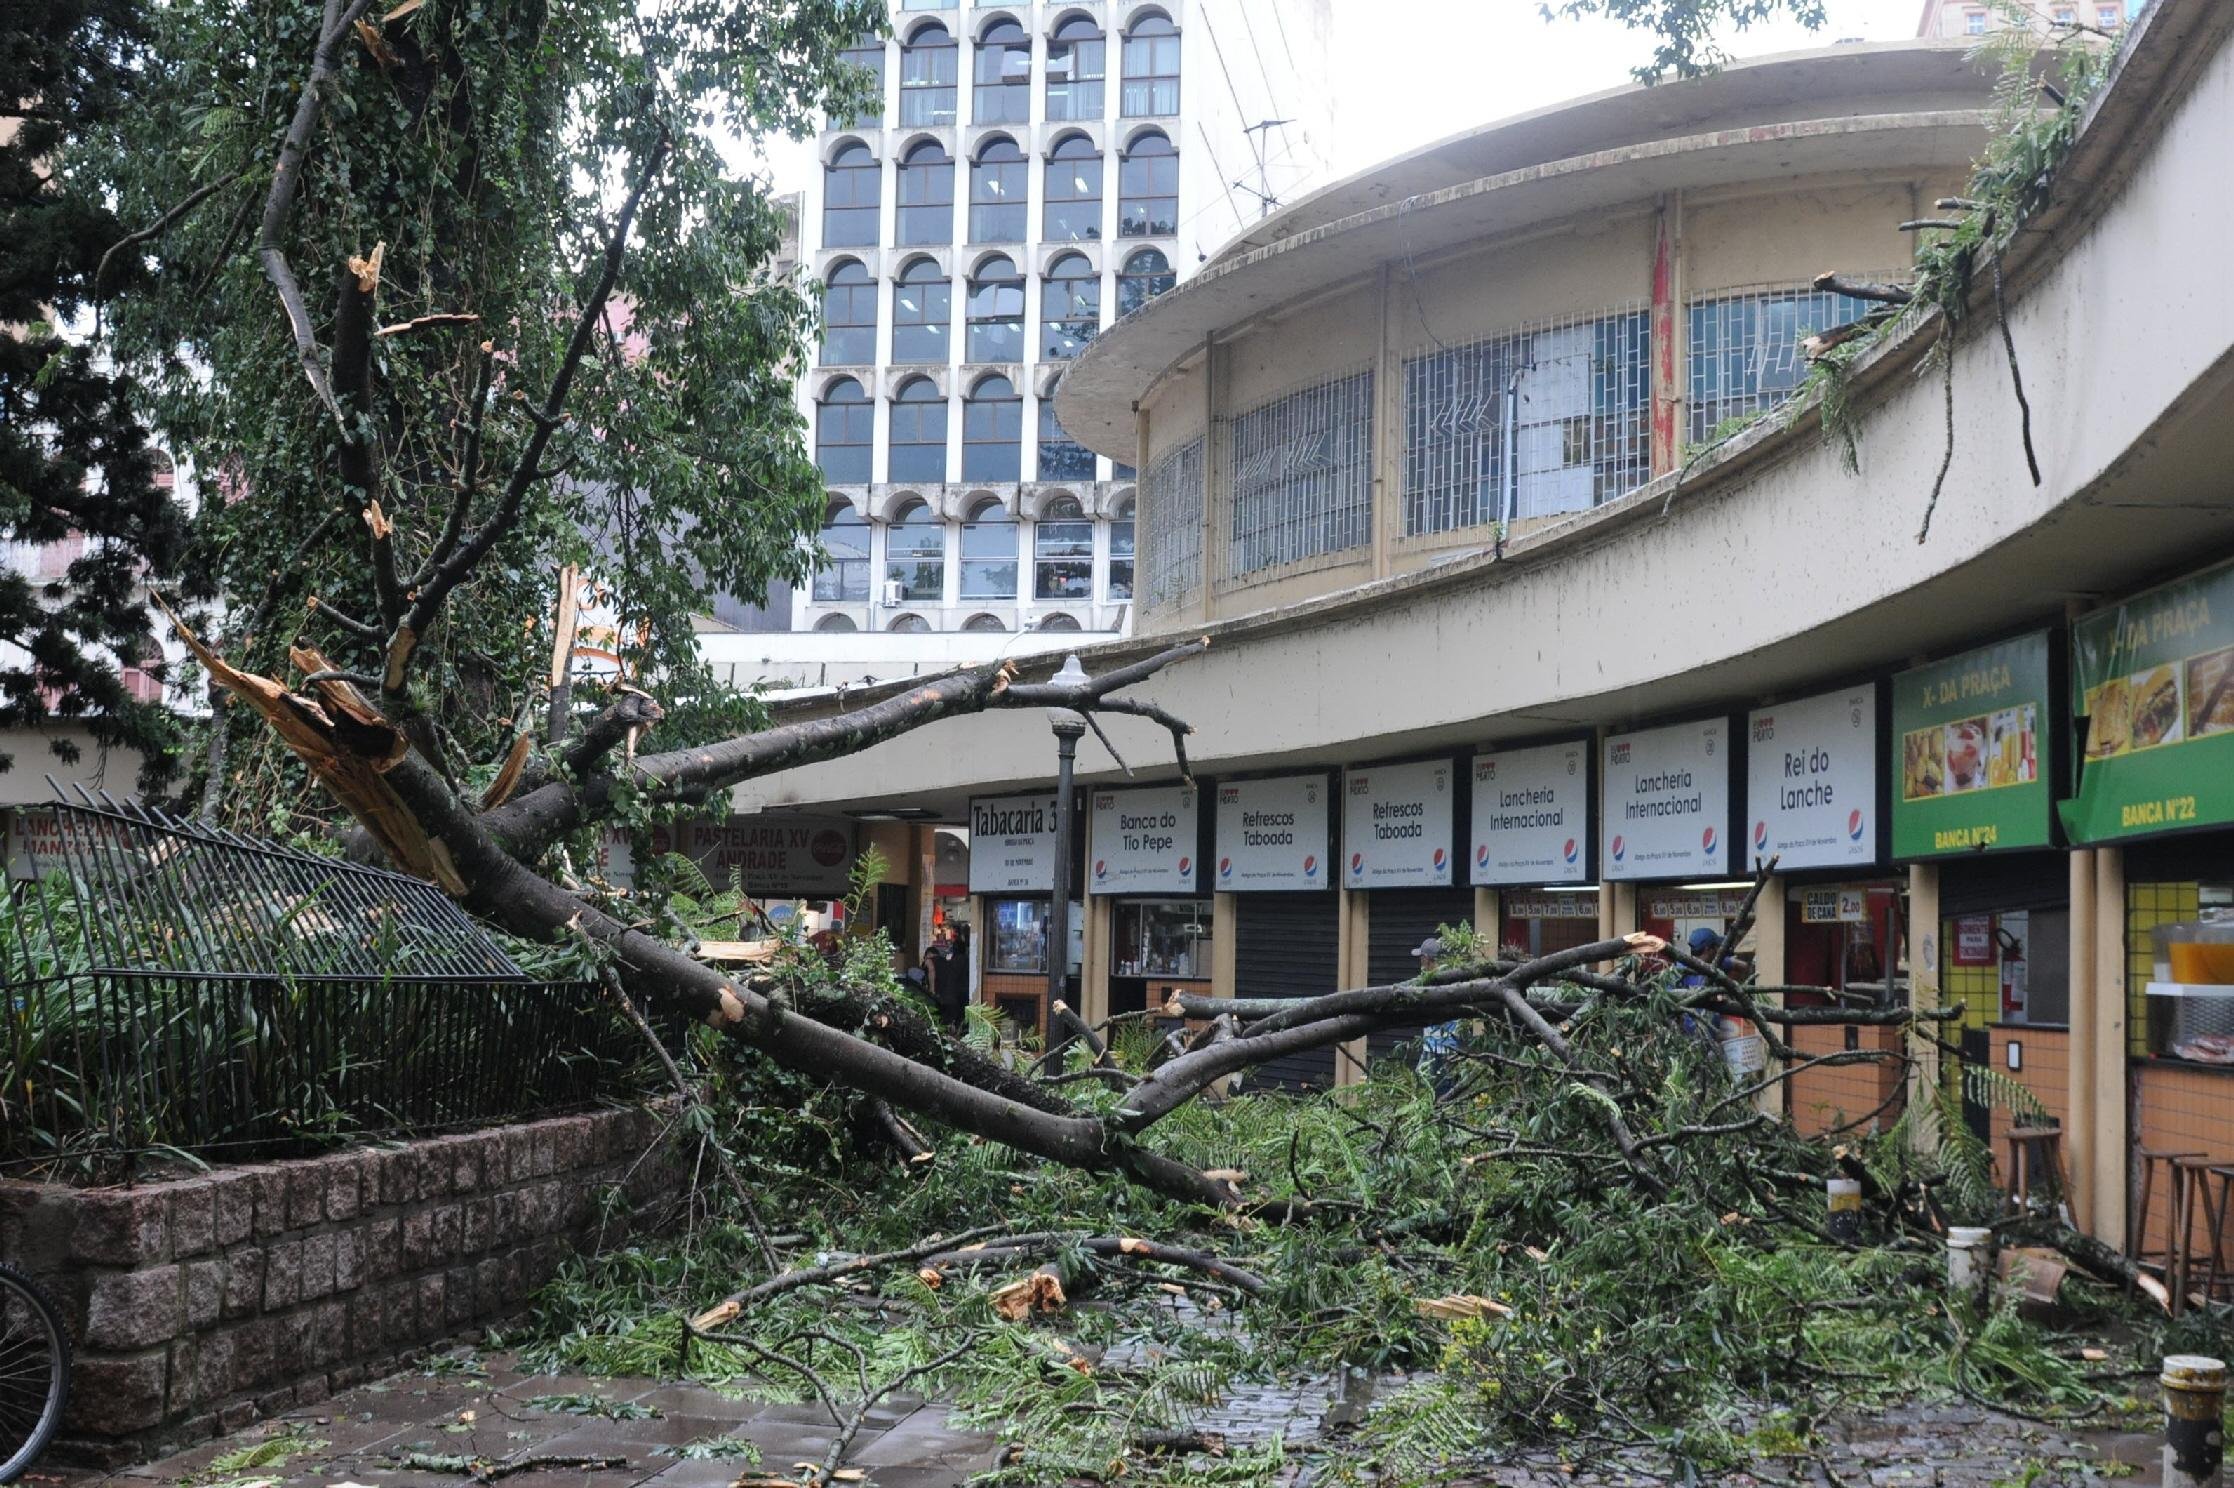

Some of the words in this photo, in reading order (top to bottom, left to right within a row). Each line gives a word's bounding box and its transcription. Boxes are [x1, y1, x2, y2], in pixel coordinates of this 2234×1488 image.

[2152, 597, 2211, 643] PRAÇA
[1940, 679, 1958, 704] DA
[1962, 665, 2011, 699] PRAÇA
[1784, 749, 1805, 778] Rei
[1809, 746, 1829, 774] do
[1635, 768, 1692, 794] Lancheria
[1500, 787, 1554, 808] Lancheria
[1626, 792, 1702, 820] Internacional
[1780, 780, 1833, 811] Lanche
[974, 801, 1043, 836] Tabacaria
[1120, 814, 1157, 830] Banca
[1160, 811, 1176, 828] do
[1242, 810, 1294, 828] Refrescos
[1373, 801, 1424, 820] Refrescos
[1490, 808, 1563, 830] Internacional
[2122, 800, 2164, 827] BANCA
[694, 826, 786, 848] PASTELARIA
[788, 828, 811, 848] XV
[1243, 829, 1293, 847] Taboada
[1374, 820, 1422, 840] Taboada
[1935, 828, 1969, 849] BANCA
[1123, 834, 1140, 850] Tio
[1143, 834, 1173, 854] Pepe
[716, 851, 787, 870] ANDRADE
[1807, 892, 1836, 906] CALDO
